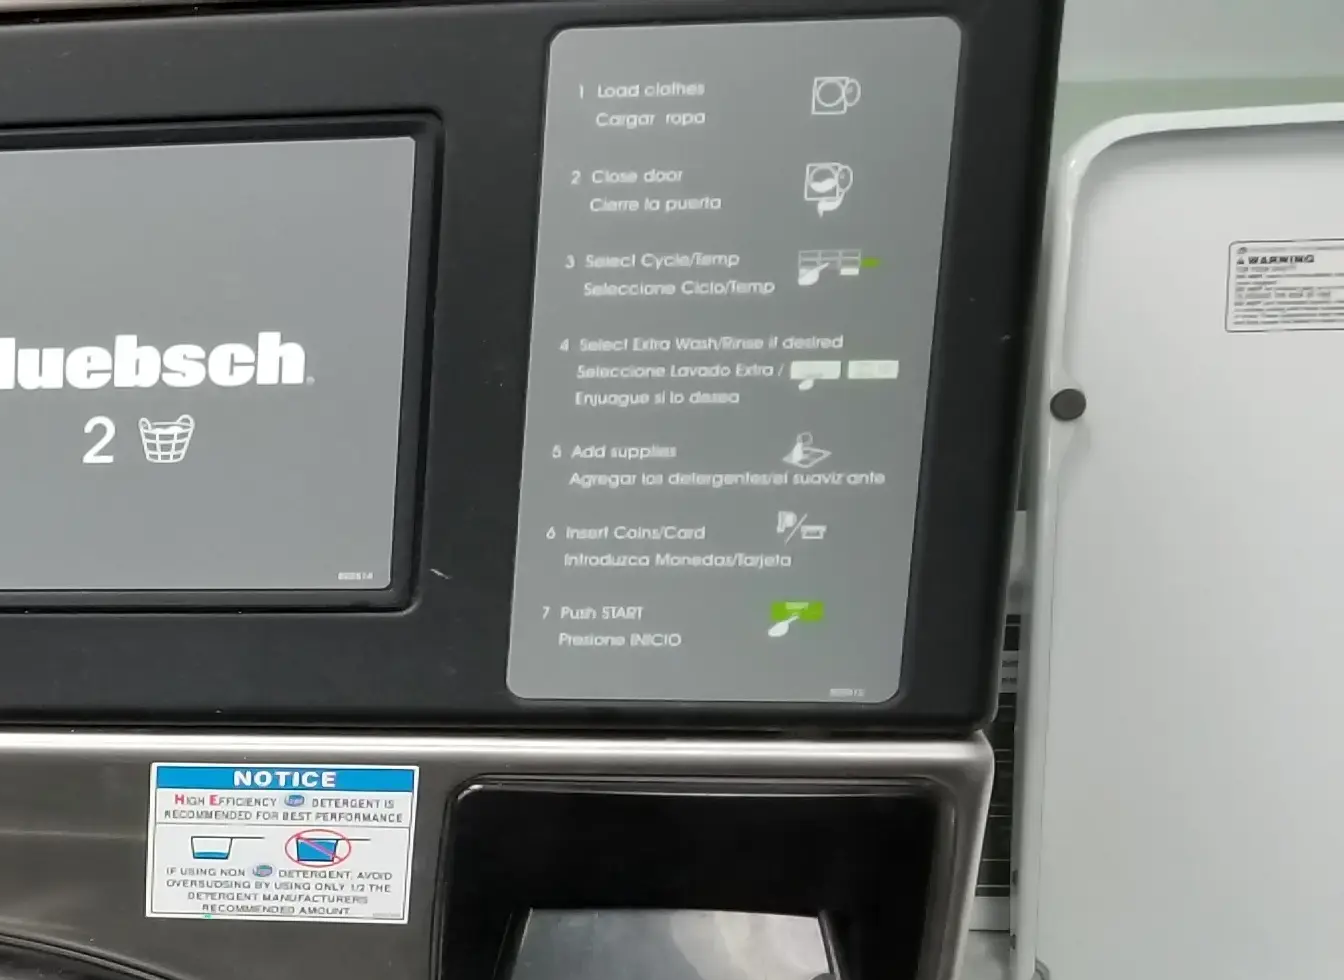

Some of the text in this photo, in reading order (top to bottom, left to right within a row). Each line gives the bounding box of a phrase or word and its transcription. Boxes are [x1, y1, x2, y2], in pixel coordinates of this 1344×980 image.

[597, 83, 640, 98] Load
[644, 82, 705, 97] clothes
[596, 112, 705, 129] Cargar ropa
[571, 168, 683, 185] 2 Close door
[590, 196, 722, 212] Cierre la puerta
[565, 252, 740, 270] 3 Select Cycle/Temp
[583, 280, 775, 298] Seleccione Ciclo/Temp
[580, 338, 628, 352] Select
[633, 337, 670, 351] Extra
[675, 335, 764, 352] Wash/Rinse
[769, 335, 778, 349] if
[782, 334, 844, 349] desired
[577, 364, 666, 379] Seleccione
[670, 363, 731, 378] Lavado
[735, 362, 774, 377] Extra
[575, 391, 649, 408] Enjuague
[82, 415, 116, 464] 2
[571, 444, 606, 459] Add
[611, 444, 677, 461] supplies
[568, 472, 637, 489] Agregar
[641, 472, 664, 486] los
[546, 525, 706, 541] 6 Insert Coins/Card
[564, 552, 792, 570] Introduzca Monedas/Tarjeta
[542, 605, 644, 620] 7 Push START
[558, 632, 683, 647] Presione INICIO
[233, 770, 337, 788] NOTICE
[174, 794, 395, 809] HIGH EFFICIENCY DETERGENT IS
[164, 809, 403, 823] RECOMMENDED FOR BEST PERFORMANCE
[357, 871, 393, 881] AVOID
